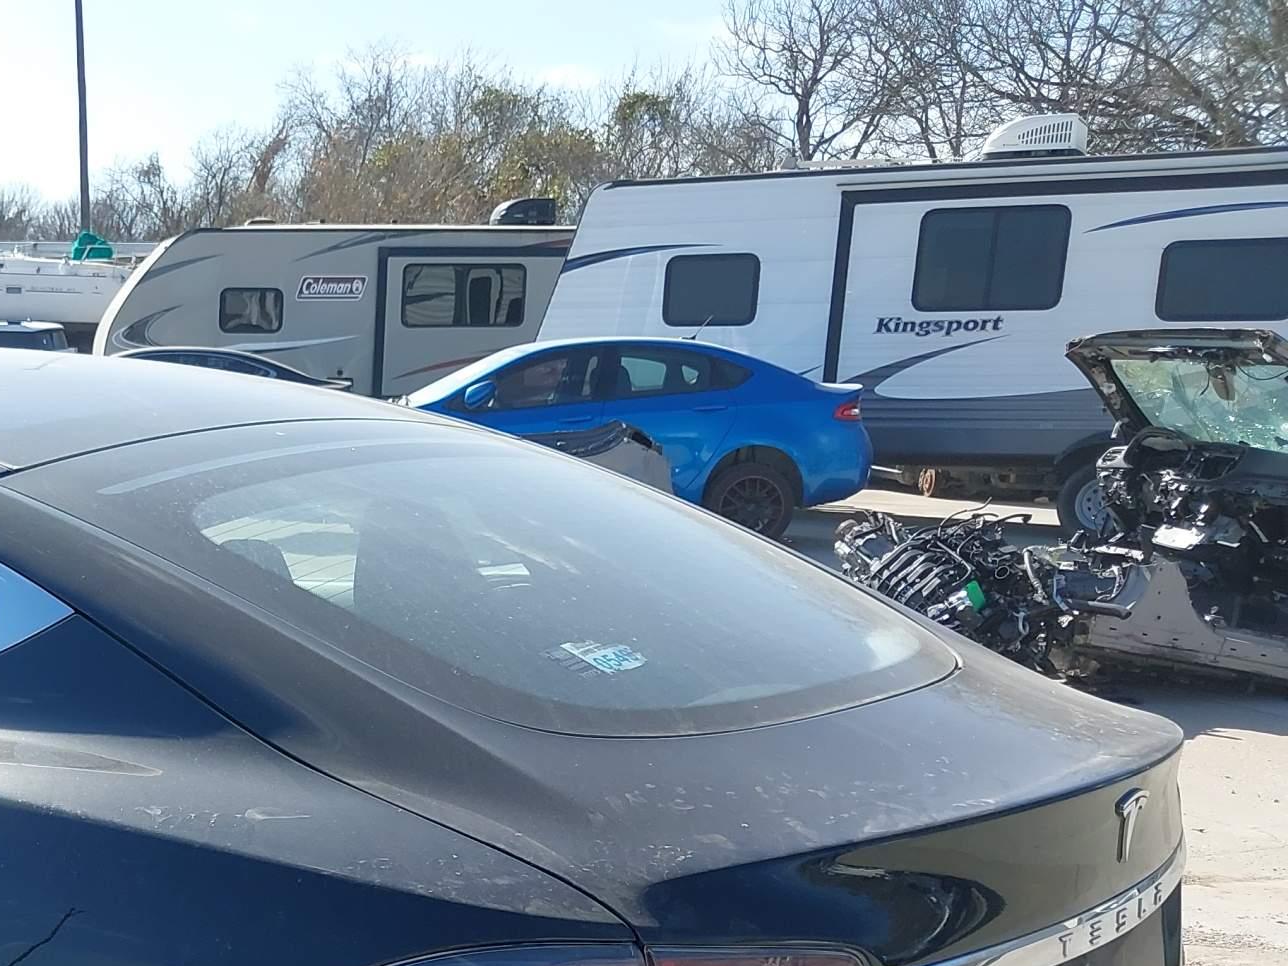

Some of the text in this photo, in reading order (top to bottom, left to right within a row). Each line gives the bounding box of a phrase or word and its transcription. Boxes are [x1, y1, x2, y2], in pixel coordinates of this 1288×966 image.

[302, 278, 352, 295] Coleman
[872, 315, 1005, 338] Kingsport
[1058, 880, 1164, 959] TESLA
